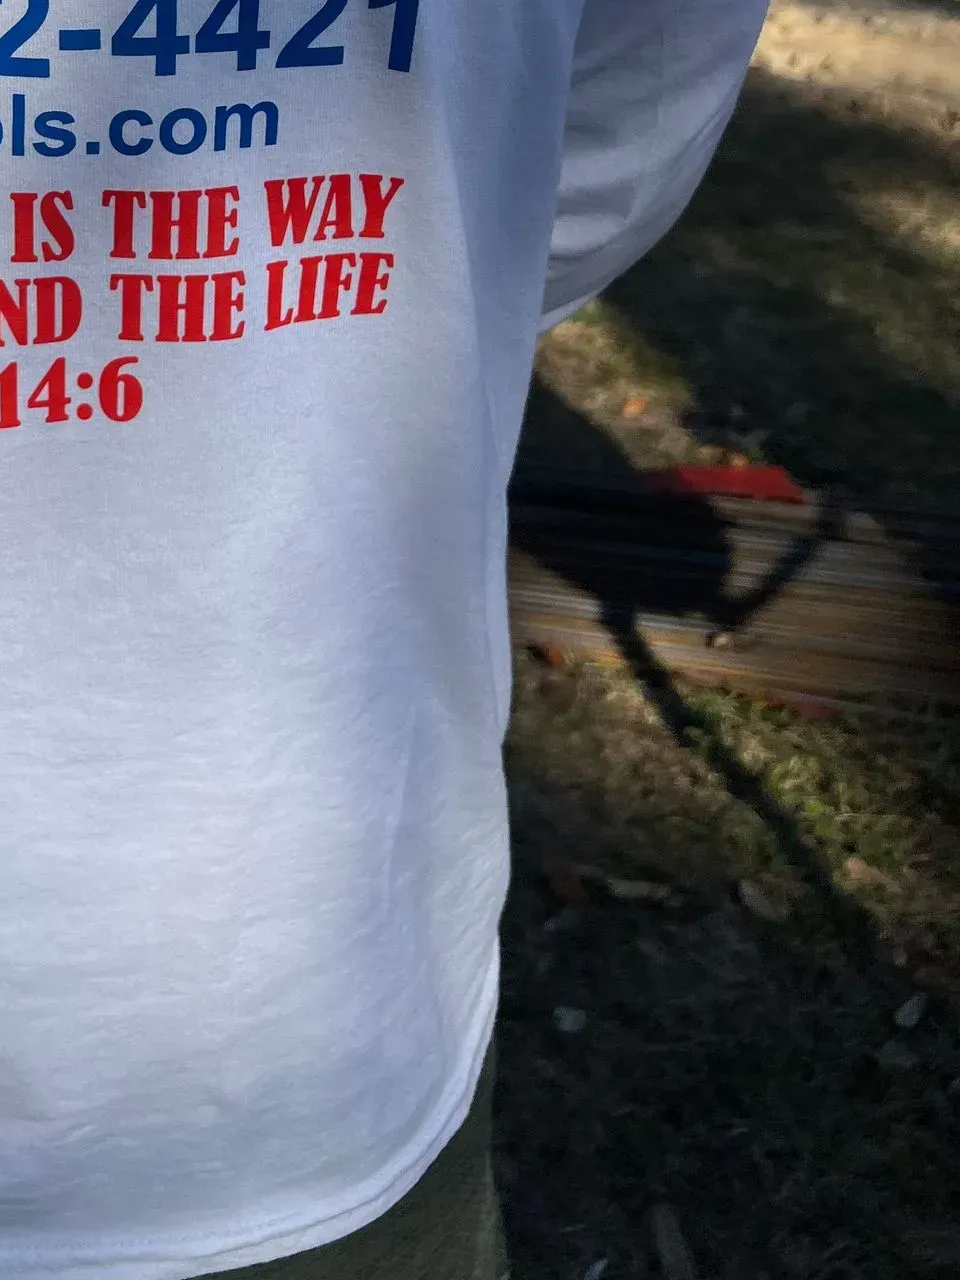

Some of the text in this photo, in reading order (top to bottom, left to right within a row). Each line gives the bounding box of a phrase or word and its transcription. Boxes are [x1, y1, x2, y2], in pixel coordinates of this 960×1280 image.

[11, 192, 74, 263] IS
[103, 183, 239, 260] THE
[264, 174, 403, 247] WAY
[110, 271, 245, 342] THE
[265, 252, 394, 331] LIFE
